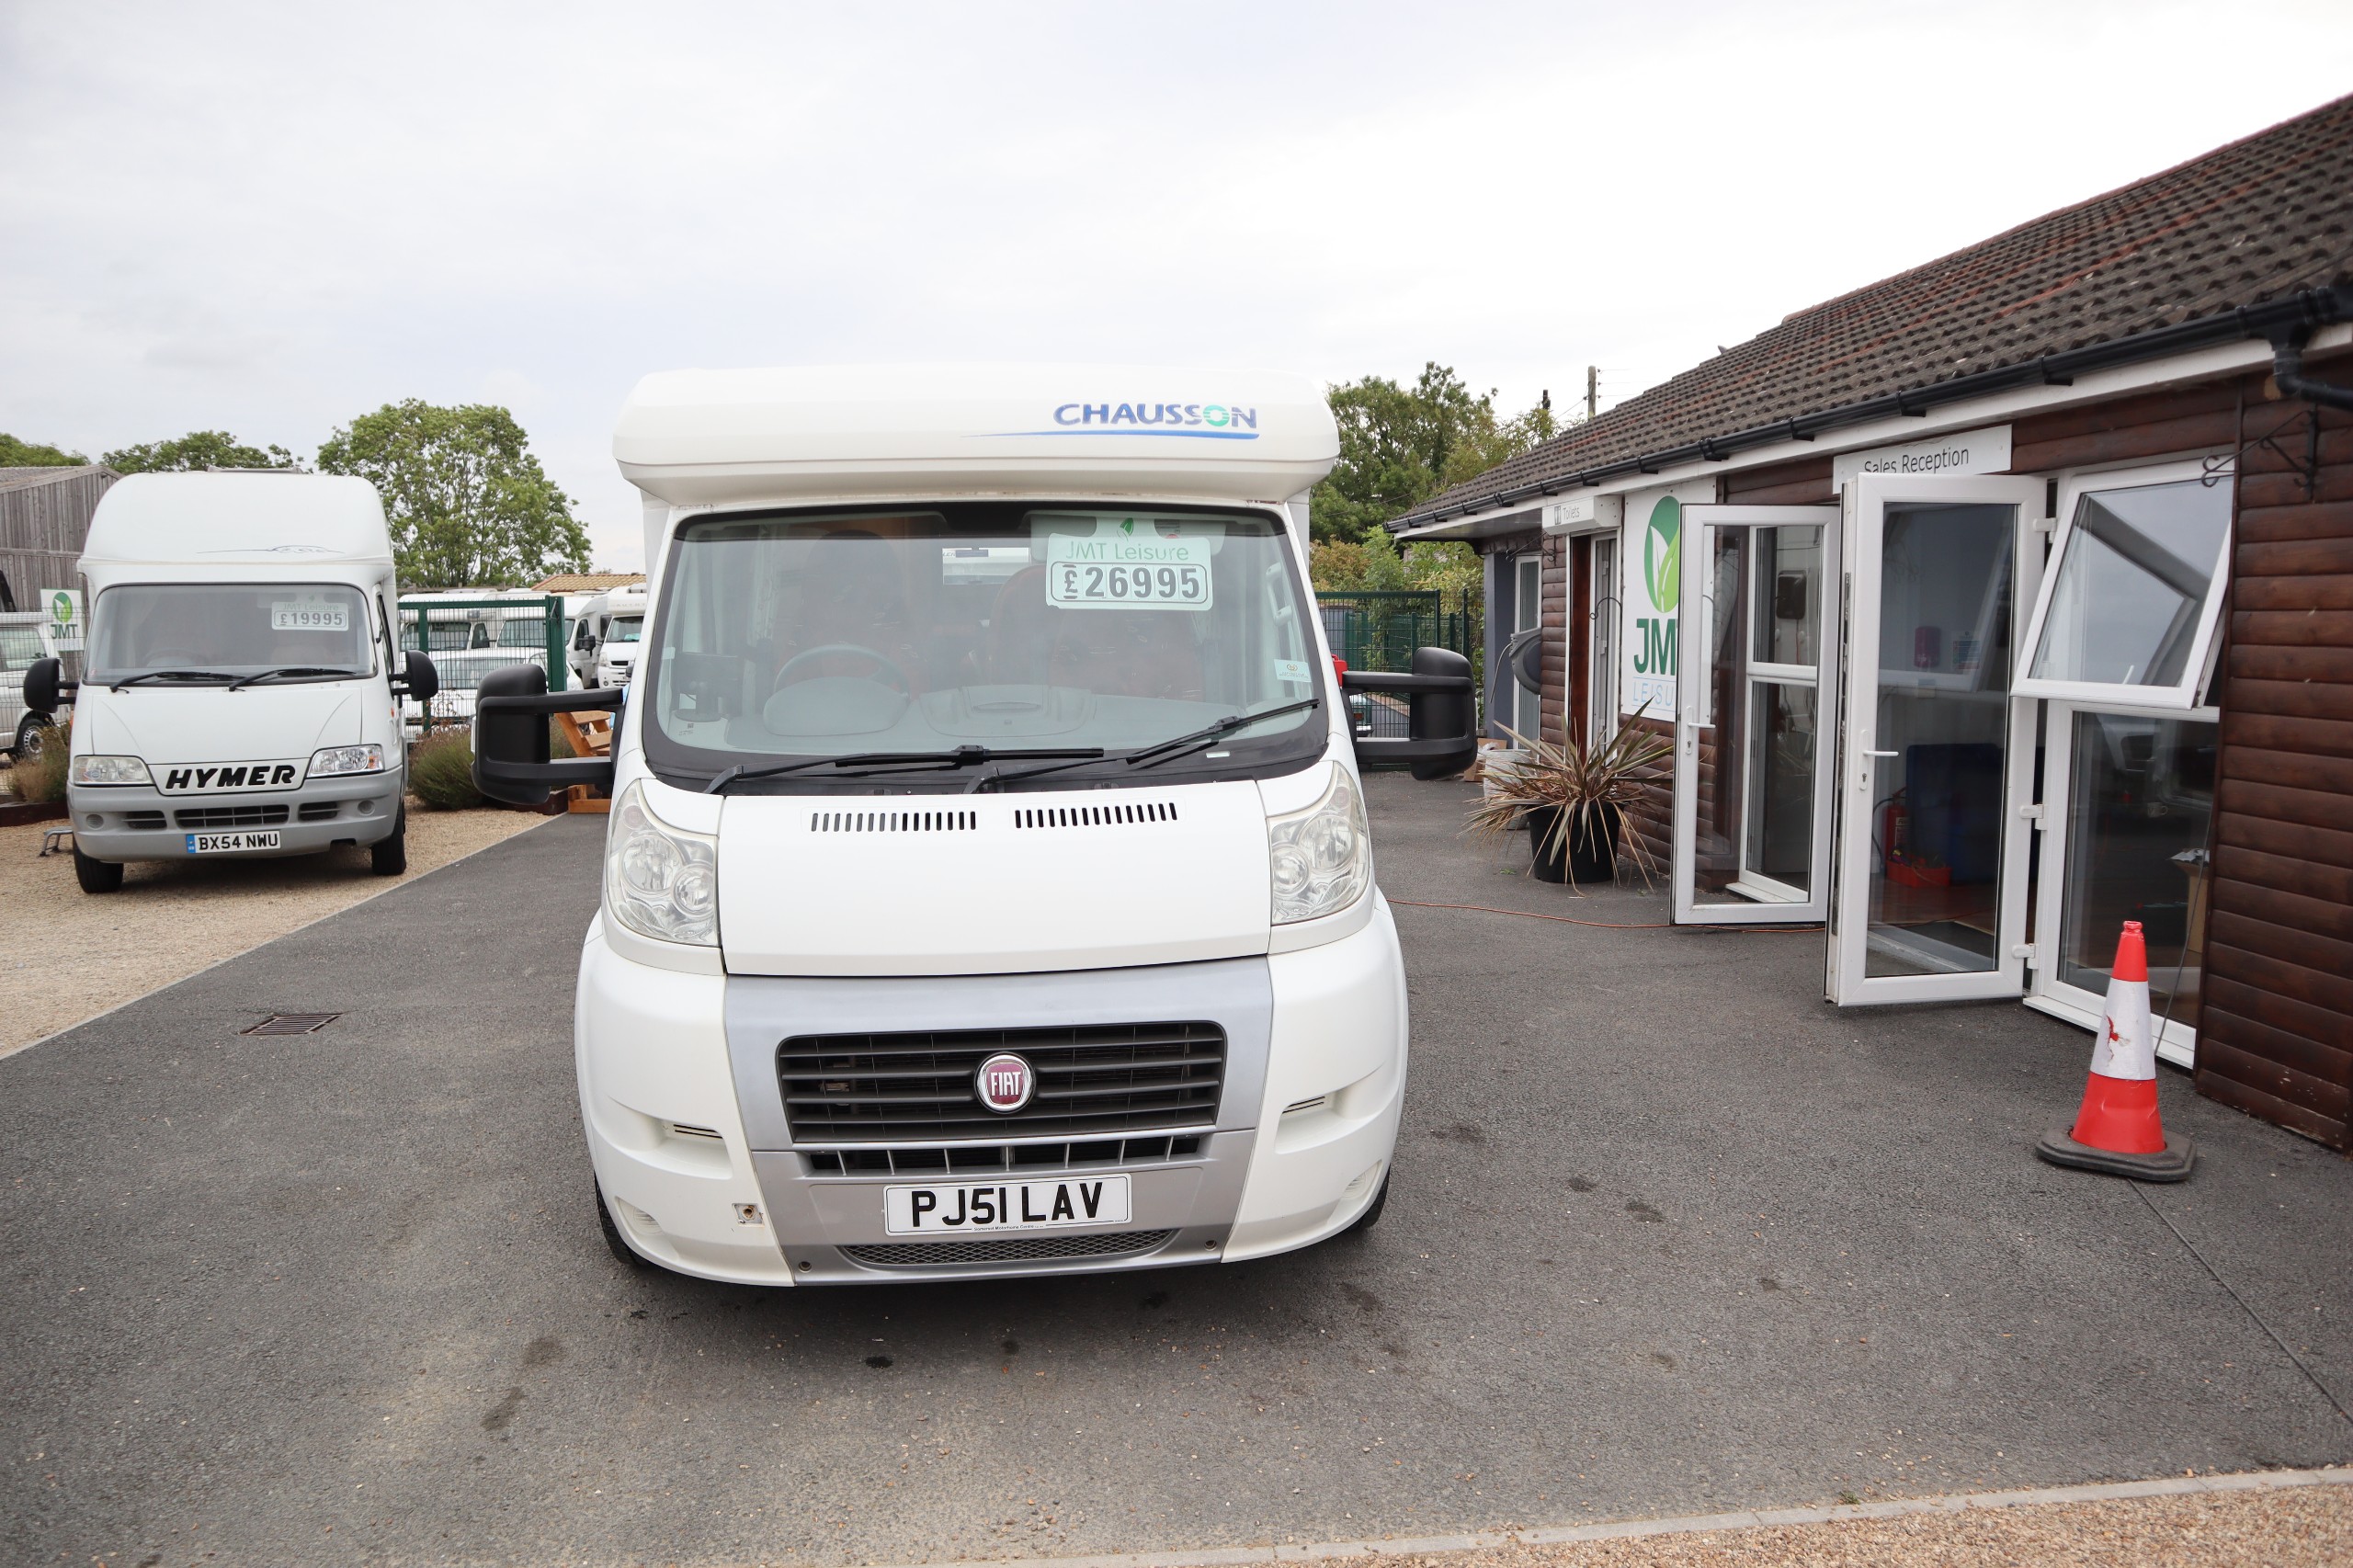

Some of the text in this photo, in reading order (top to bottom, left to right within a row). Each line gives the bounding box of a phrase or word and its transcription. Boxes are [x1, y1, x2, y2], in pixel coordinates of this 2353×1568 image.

[1052, 403, 1257, 429] CHAUSSON
[1902, 447, 1970, 473] Reception
[1065, 540, 1189, 561] JMT Leisure
[1063, 565, 1200, 599] £26995
[279, 612, 344, 626] £19995
[283, 602, 339, 611] JMT Leisure
[50, 623, 79, 640] JMT
[1633, 618, 1678, 676] JM
[1632, 682, 1675, 707] LEISU
[165, 765, 296, 790] HYMER
[199, 833, 278, 851] BX54 NWU
[990, 1071, 1021, 1096] FIAT
[911, 1182, 1103, 1228] PJ51 LAV
